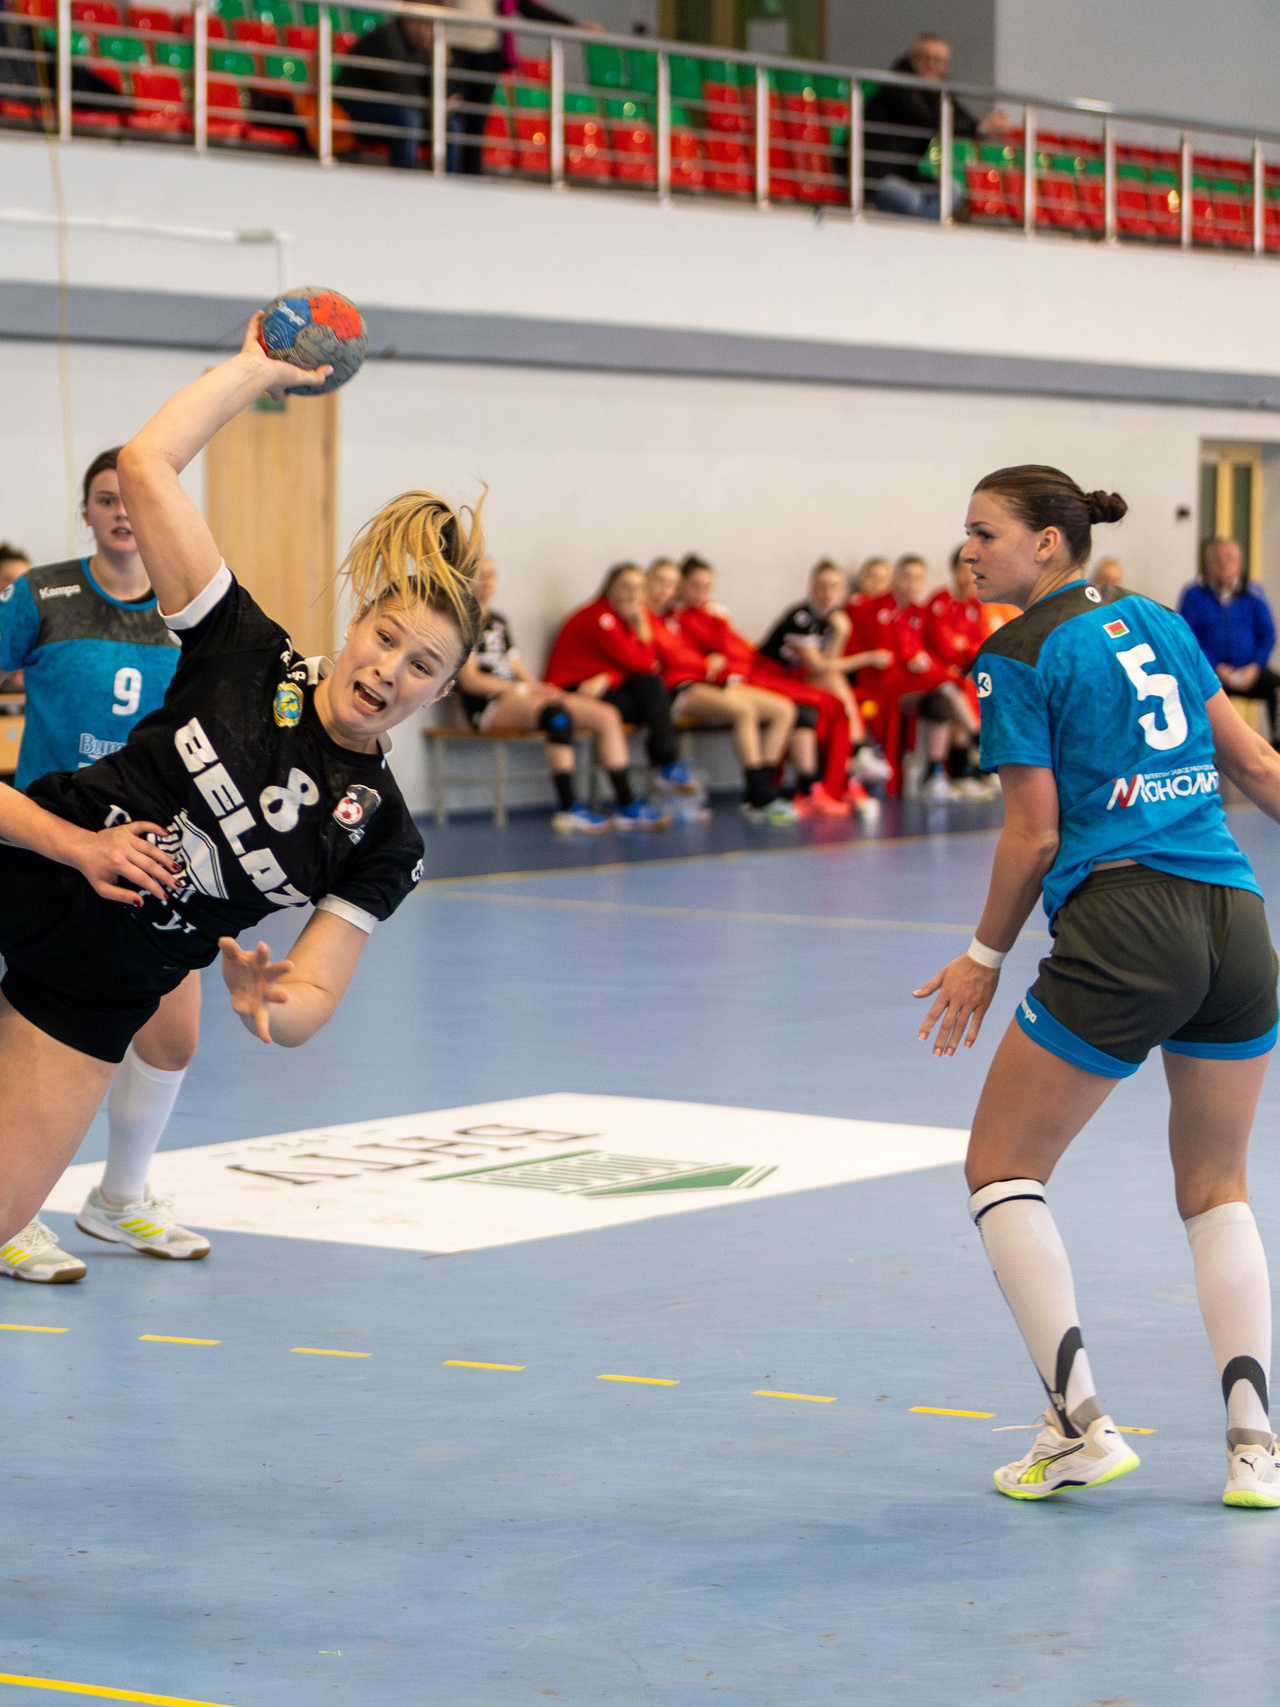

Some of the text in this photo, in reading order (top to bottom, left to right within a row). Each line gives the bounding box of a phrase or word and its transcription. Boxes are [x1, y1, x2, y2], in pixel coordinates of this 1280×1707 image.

[39, 585, 81, 599] Kempa
[112, 667, 142, 716] 9
[1116, 643, 1188, 750] 5
[259, 767, 320, 833] 8
